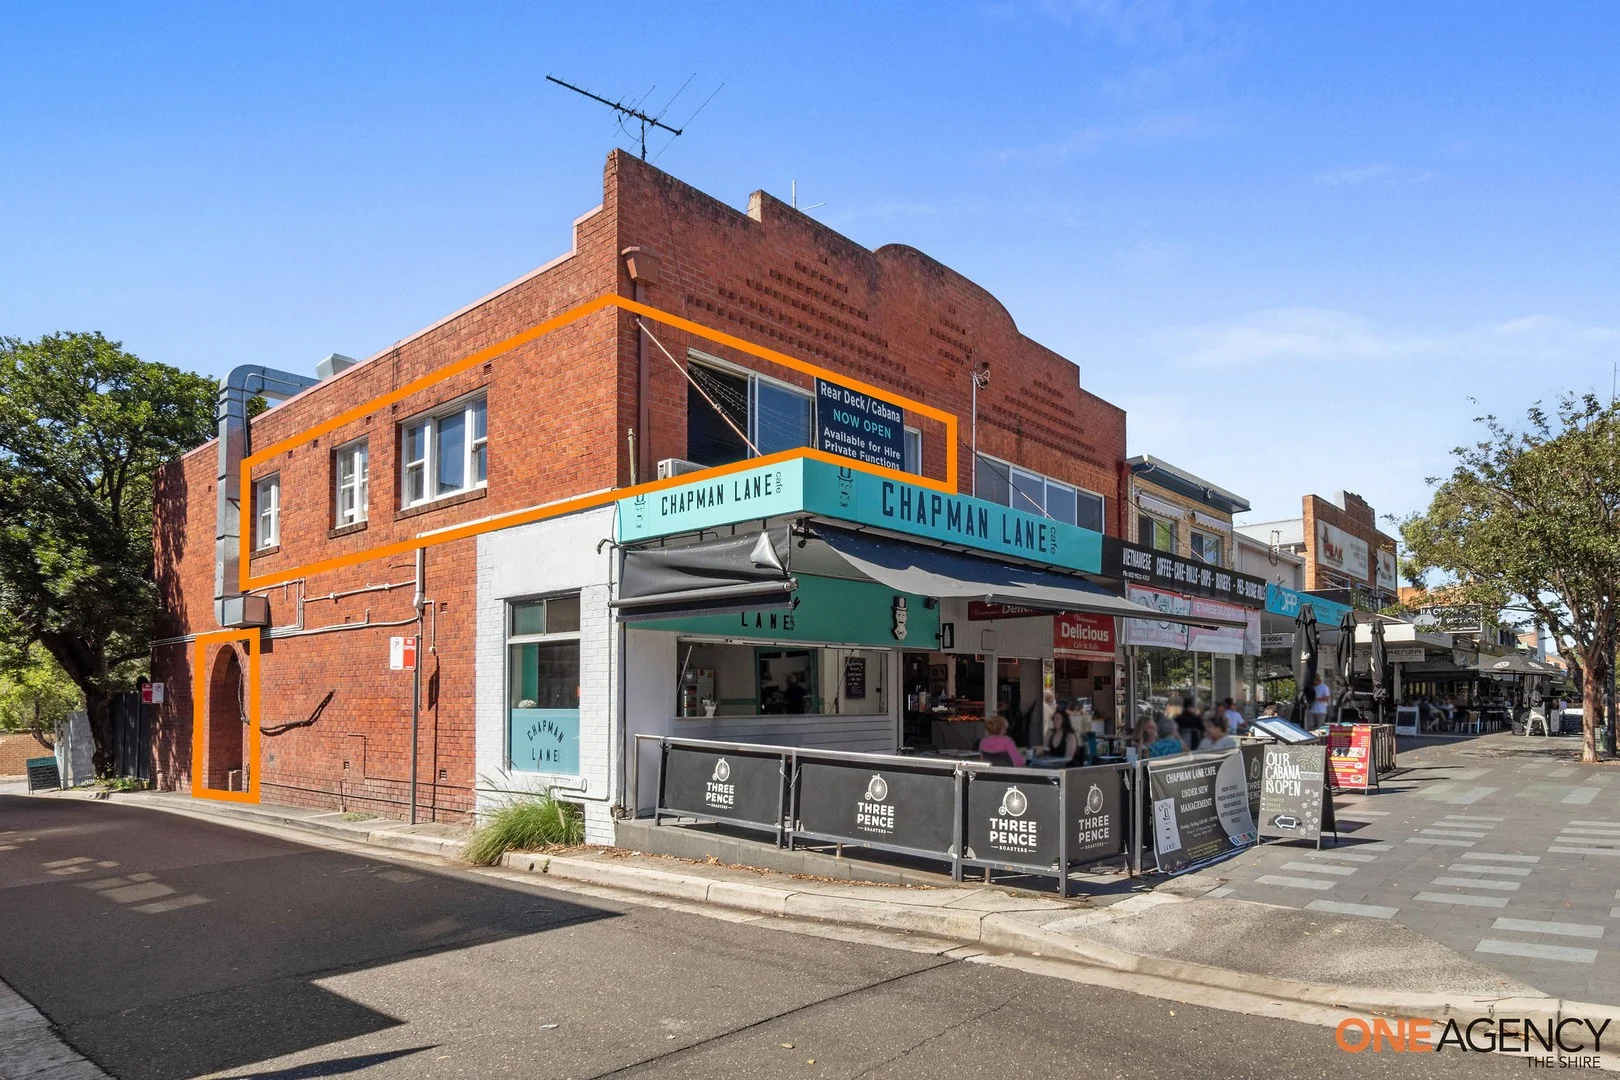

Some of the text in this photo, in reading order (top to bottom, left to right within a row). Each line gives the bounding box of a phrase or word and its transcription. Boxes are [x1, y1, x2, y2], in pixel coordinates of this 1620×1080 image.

[820, 382, 842, 402] Rear
[833, 408, 892, 439] NOW OPEN
[824, 427, 900, 460] Available for Hire
[824, 440, 900, 470] Private Functions
[661, 484, 724, 516] CHAPMAN
[734, 474, 772, 502] LANE
[882, 481, 988, 539] CHAPMAN
[1002, 514, 1047, 552] LANE
[742, 612, 790, 630] LANE
[1061, 622, 1109, 642] Delicious
[527, 720, 564, 744] CHAPMAN
[532, 749, 558, 762] LANE
[1266, 752, 1290, 766] OUR
[1166, 766, 1216, 784] CHAPMAN LANE CAFE
[1265, 765, 1300, 780] CABANA
[706, 782, 734, 795] THREE
[1181, 785, 1209, 798] UNDER NEW
[1247, 781, 1260, 790] THRE
[1266, 780, 1300, 796] IS OPEN
[706, 792, 734, 804] PENCE
[1180, 798, 1212, 813] MANAGEMENT
[857, 802, 894, 817] THREE
[856, 814, 894, 828] PENCE
[989, 818, 1037, 833] THREE
[1078, 815, 1110, 830] THREE
[989, 831, 1037, 846] PENCE
[1078, 828, 1110, 844] PENCE
